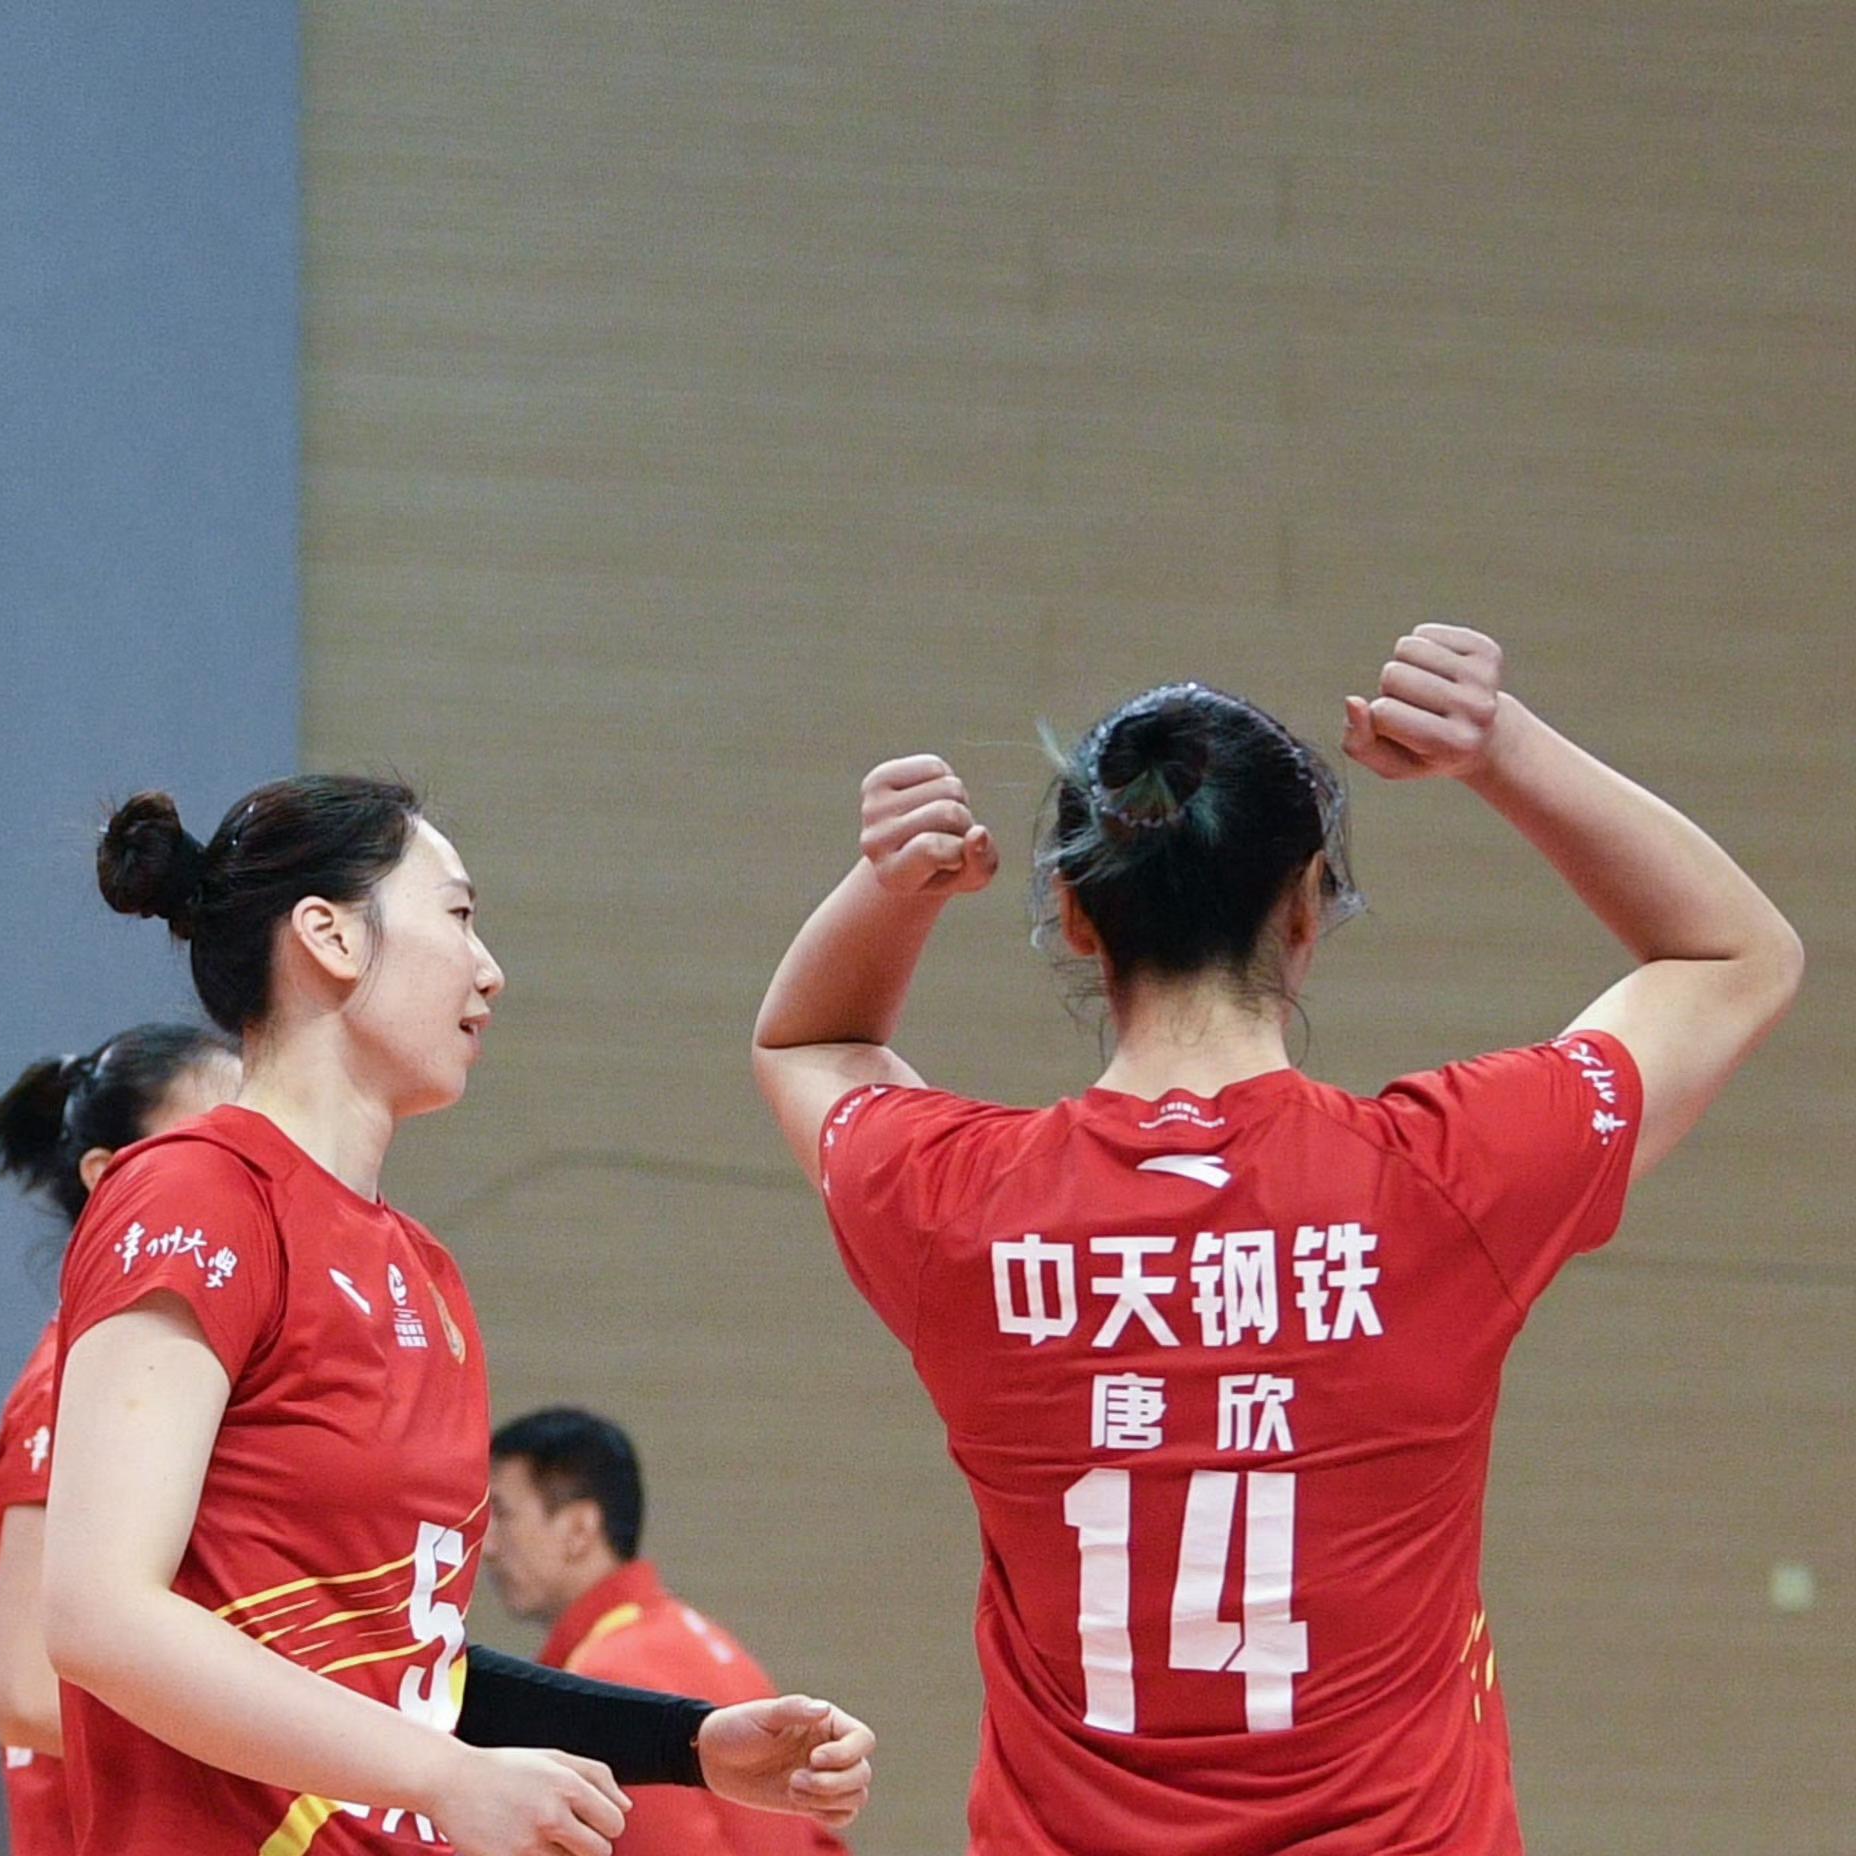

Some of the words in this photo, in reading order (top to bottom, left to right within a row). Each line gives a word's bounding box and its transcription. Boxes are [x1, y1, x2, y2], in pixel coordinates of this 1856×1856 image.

[990, 1222, 1385, 1348] 中天钢铁
[398, 1520, 466, 1736] 5
[1062, 1468, 1310, 1734] 14
